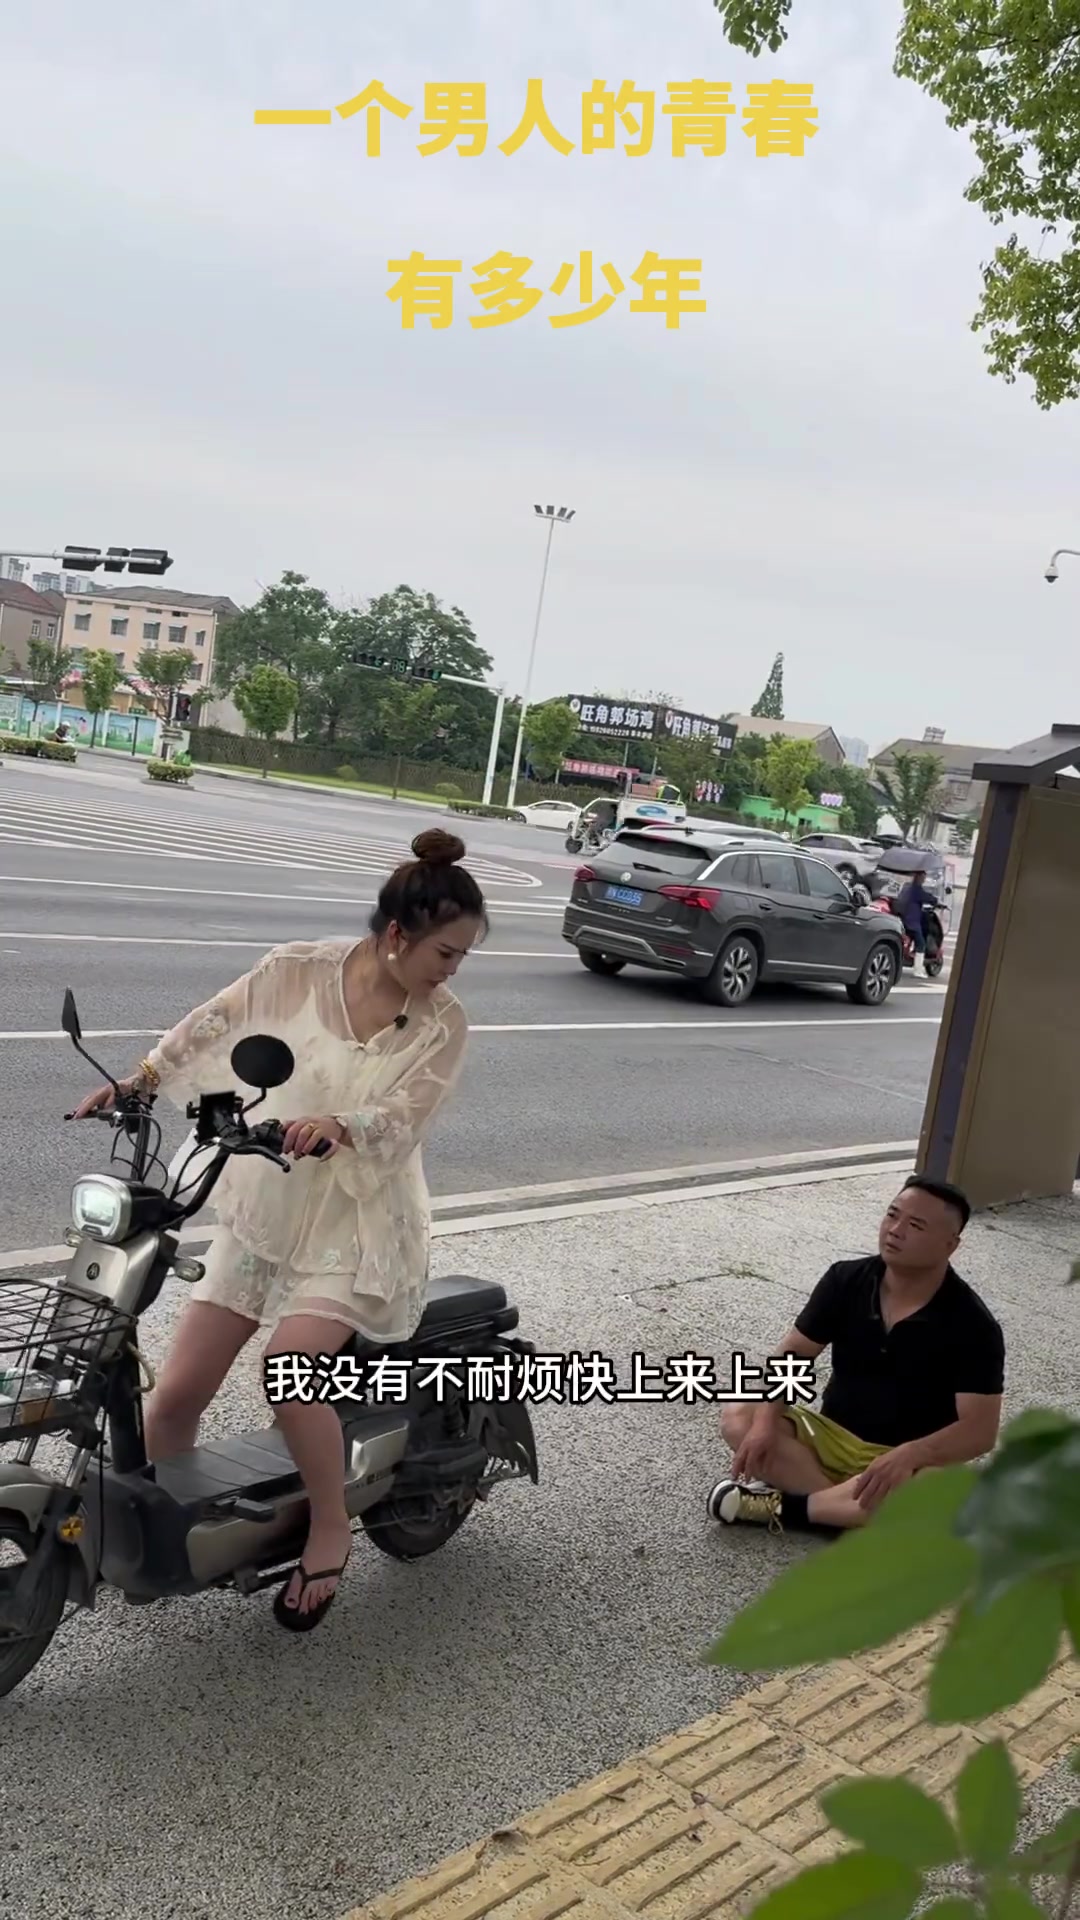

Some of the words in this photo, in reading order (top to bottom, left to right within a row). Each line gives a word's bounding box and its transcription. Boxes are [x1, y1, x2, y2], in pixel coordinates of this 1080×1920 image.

[580, 704, 654, 730] 旺角郭场鸡
